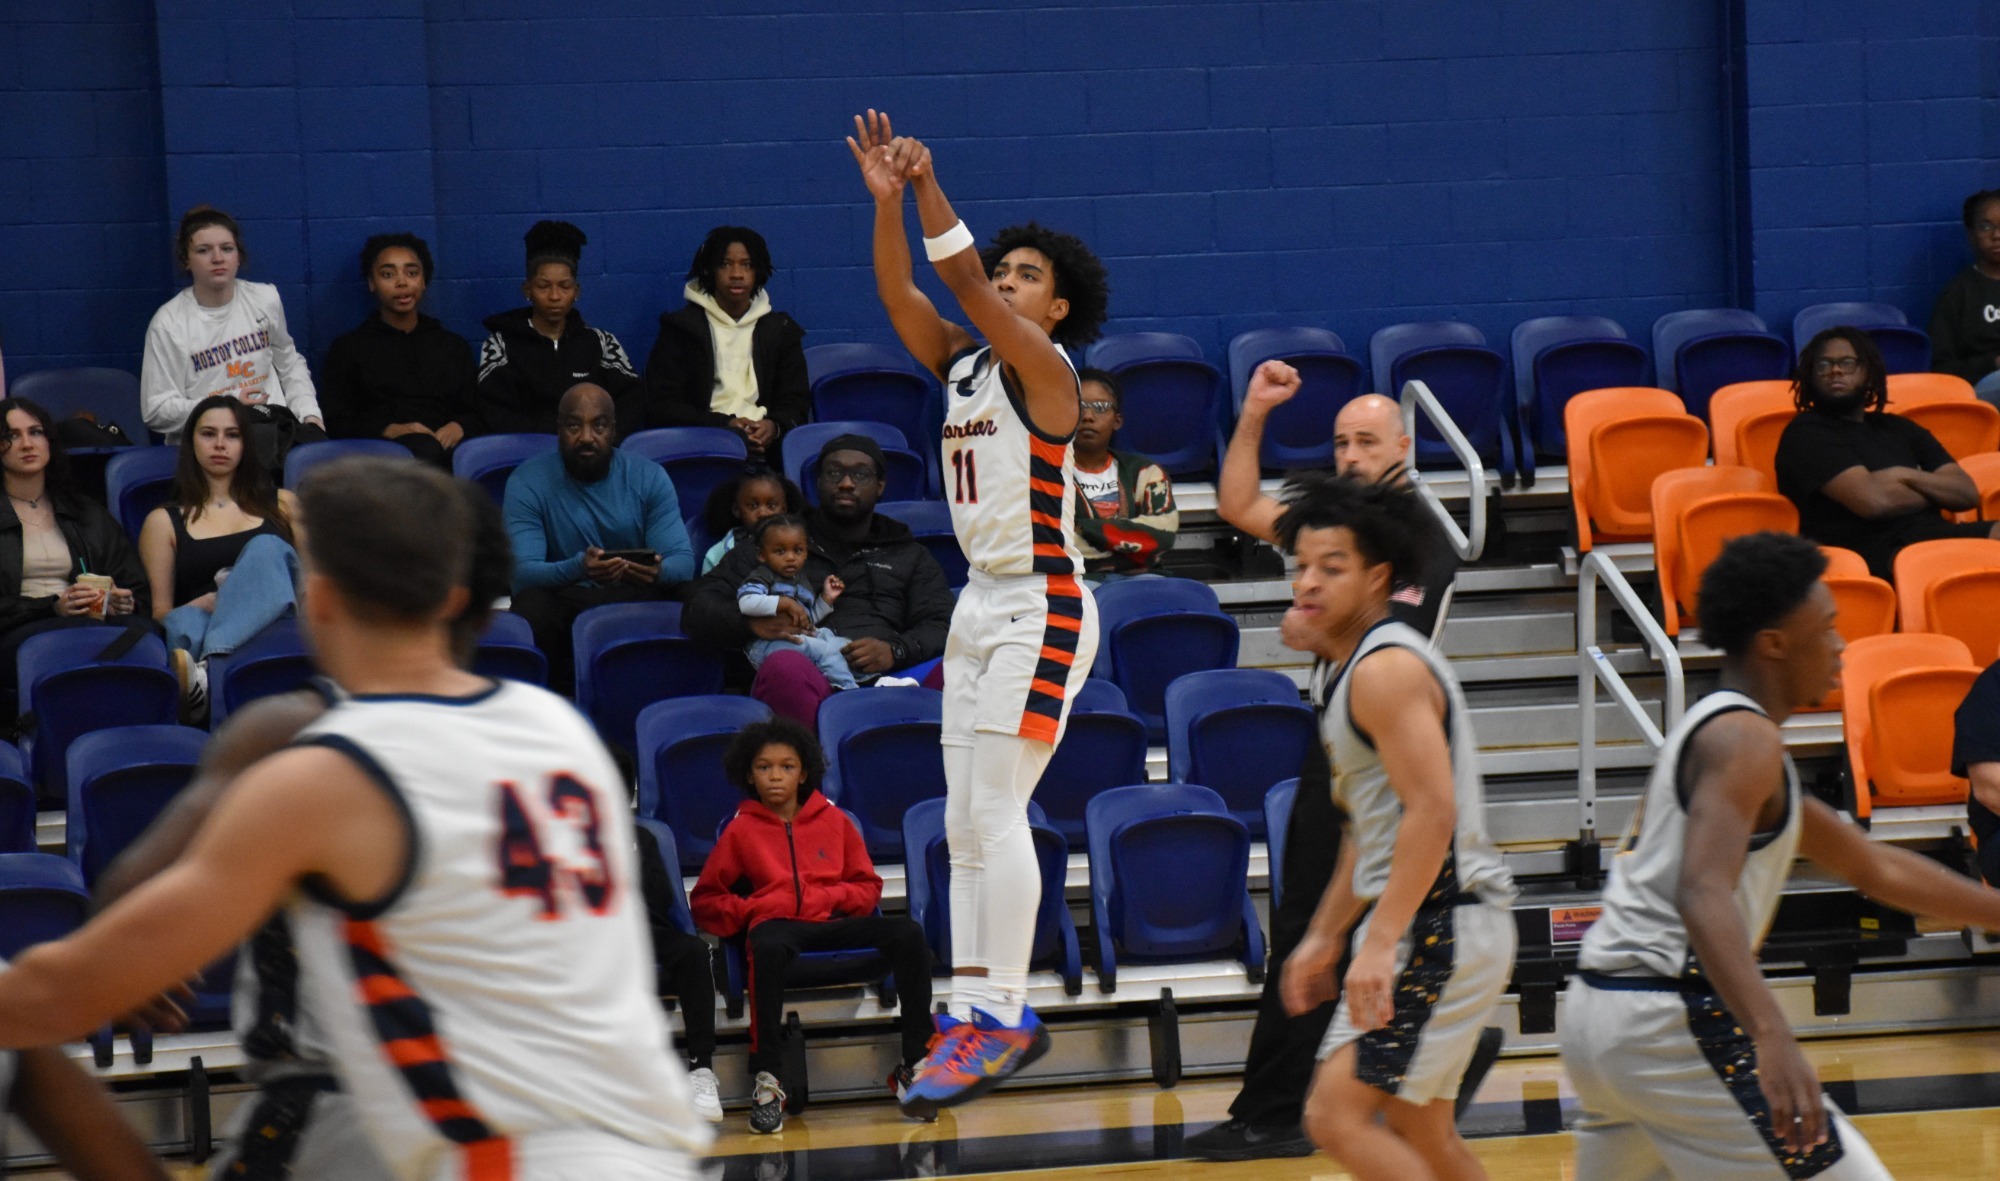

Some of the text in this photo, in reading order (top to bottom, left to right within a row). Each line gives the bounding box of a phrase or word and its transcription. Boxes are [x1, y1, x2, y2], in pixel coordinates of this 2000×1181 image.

[191, 341, 232, 372] MORTON
[226, 360, 256, 379] MC
[942, 419, 998, 439] orton
[951, 448, 978, 504] 11
[488, 769, 618, 922] 43
